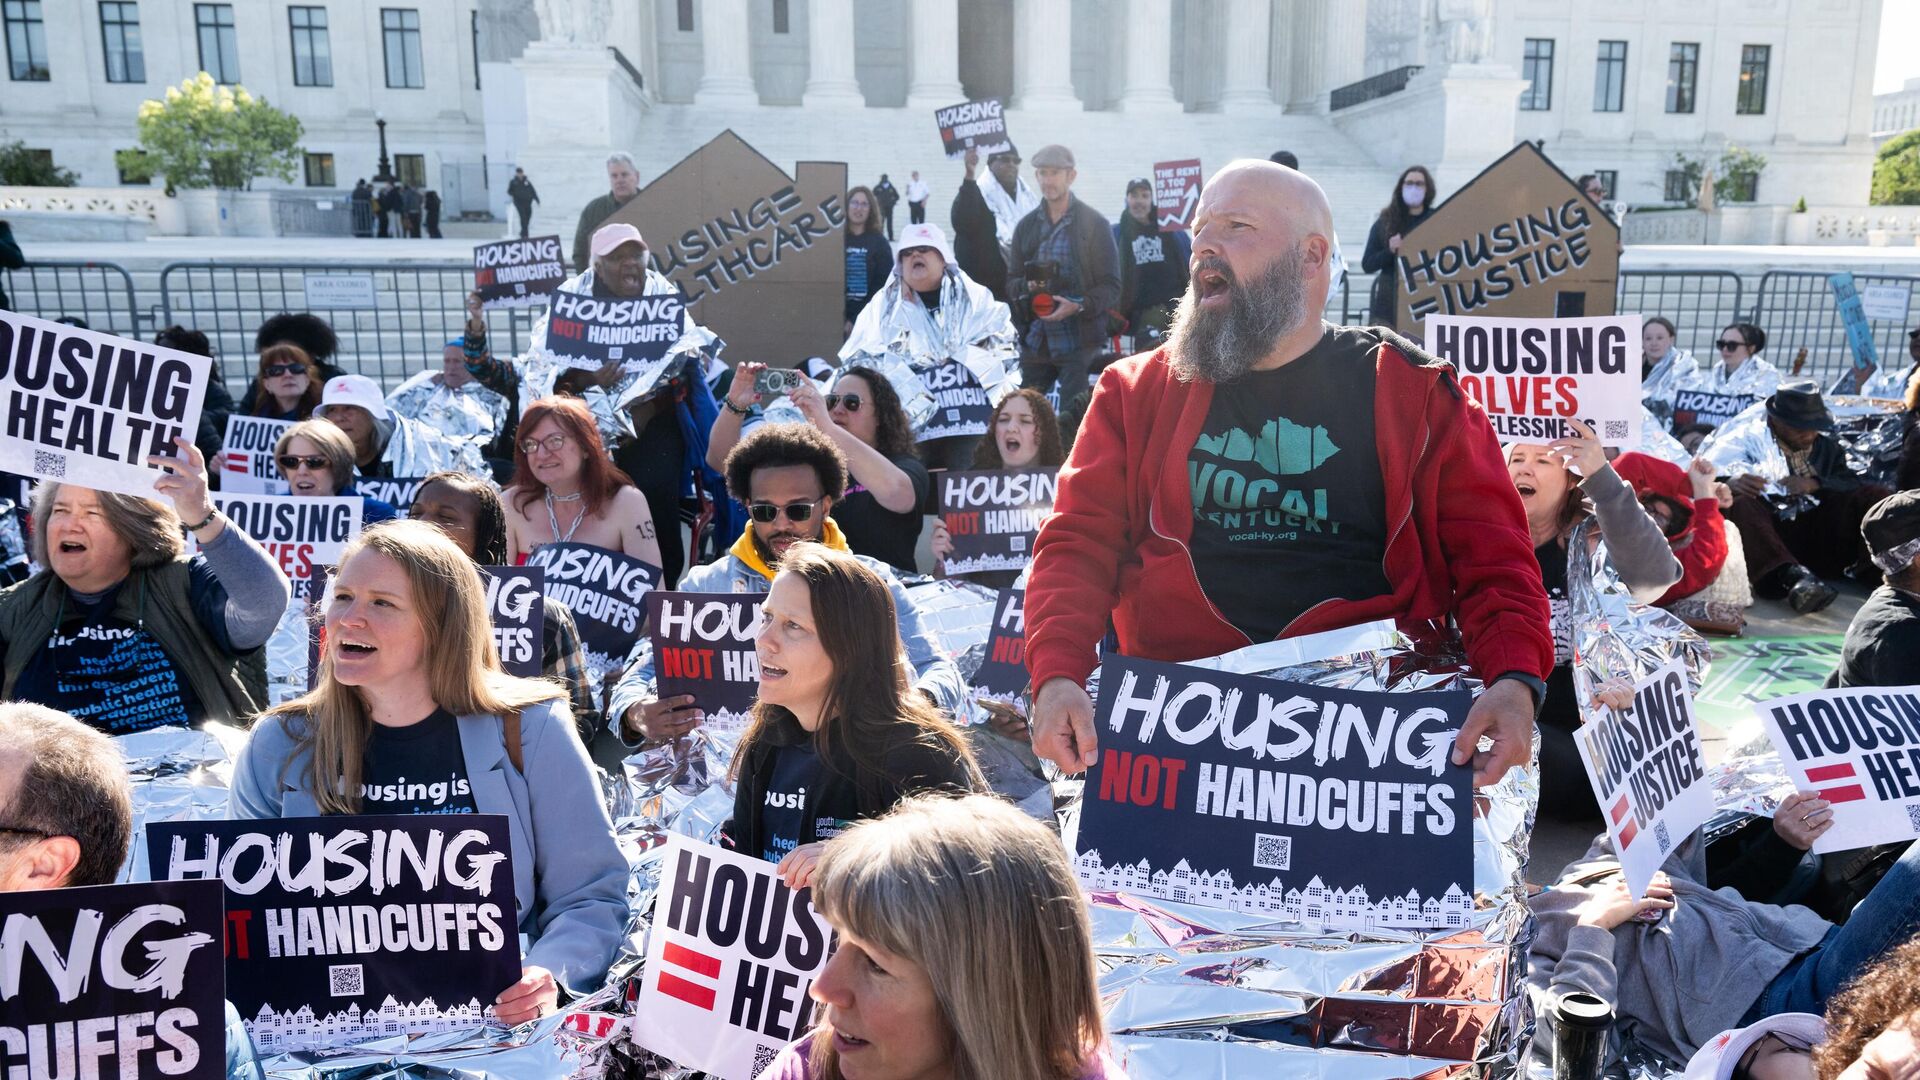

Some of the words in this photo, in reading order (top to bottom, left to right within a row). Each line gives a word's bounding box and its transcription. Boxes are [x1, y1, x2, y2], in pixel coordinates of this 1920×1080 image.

[938, 100, 1002, 128] HOUSING
[1156, 169, 1174, 178] THE
[1177, 166, 1200, 176] RENT
[1157, 180, 1165, 188] IS
[1168, 178, 1186, 187] TOO
[475, 239, 561, 268] HOUSING
[673, 194, 846, 306] LTHCARE
[1400, 198, 1592, 294] HOUSING
[496, 261, 563, 284] HANDCUFFS
[555, 294, 685, 324] HOUSING
[552, 319, 585, 341] NOT
[588, 323, 679, 345] HANDCUFFS
[1437, 324, 1626, 375] HOUSING
[0, 319, 193, 423] USING
[1460, 375, 1579, 417] OLVES
[7, 390, 183, 475] HEALTH
[228, 420, 288, 453] HOUS
[944, 472, 1060, 510] HOUSIN
[945, 512, 980, 535] NOT
[1228, 531, 1297, 542] vocal-ky.org
[526, 548, 654, 605] OUSING
[543, 582, 640, 634] NDCUFFS
[662, 647, 715, 680] NOT
[991, 635, 1025, 665] NO
[104, 670, 176, 697] recovery
[123, 681, 179, 705] health
[1109, 669, 1460, 778] HOUSING
[1584, 671, 1691, 801] HOUSING
[1770, 693, 1920, 762] HOUSI
[359, 777, 448, 805] using
[451, 772, 471, 797] is
[1099, 749, 1186, 811] NOT
[1195, 762, 1456, 837] HANDCUFFS
[1629, 730, 1704, 830] JUSTICE
[816, 817, 834, 829] youth
[168, 828, 508, 898] HOUSING
[265, 902, 505, 958] HANDCUFFS
[667, 848, 838, 972] HOUS
[0, 1007, 200, 1080] CUFFS
